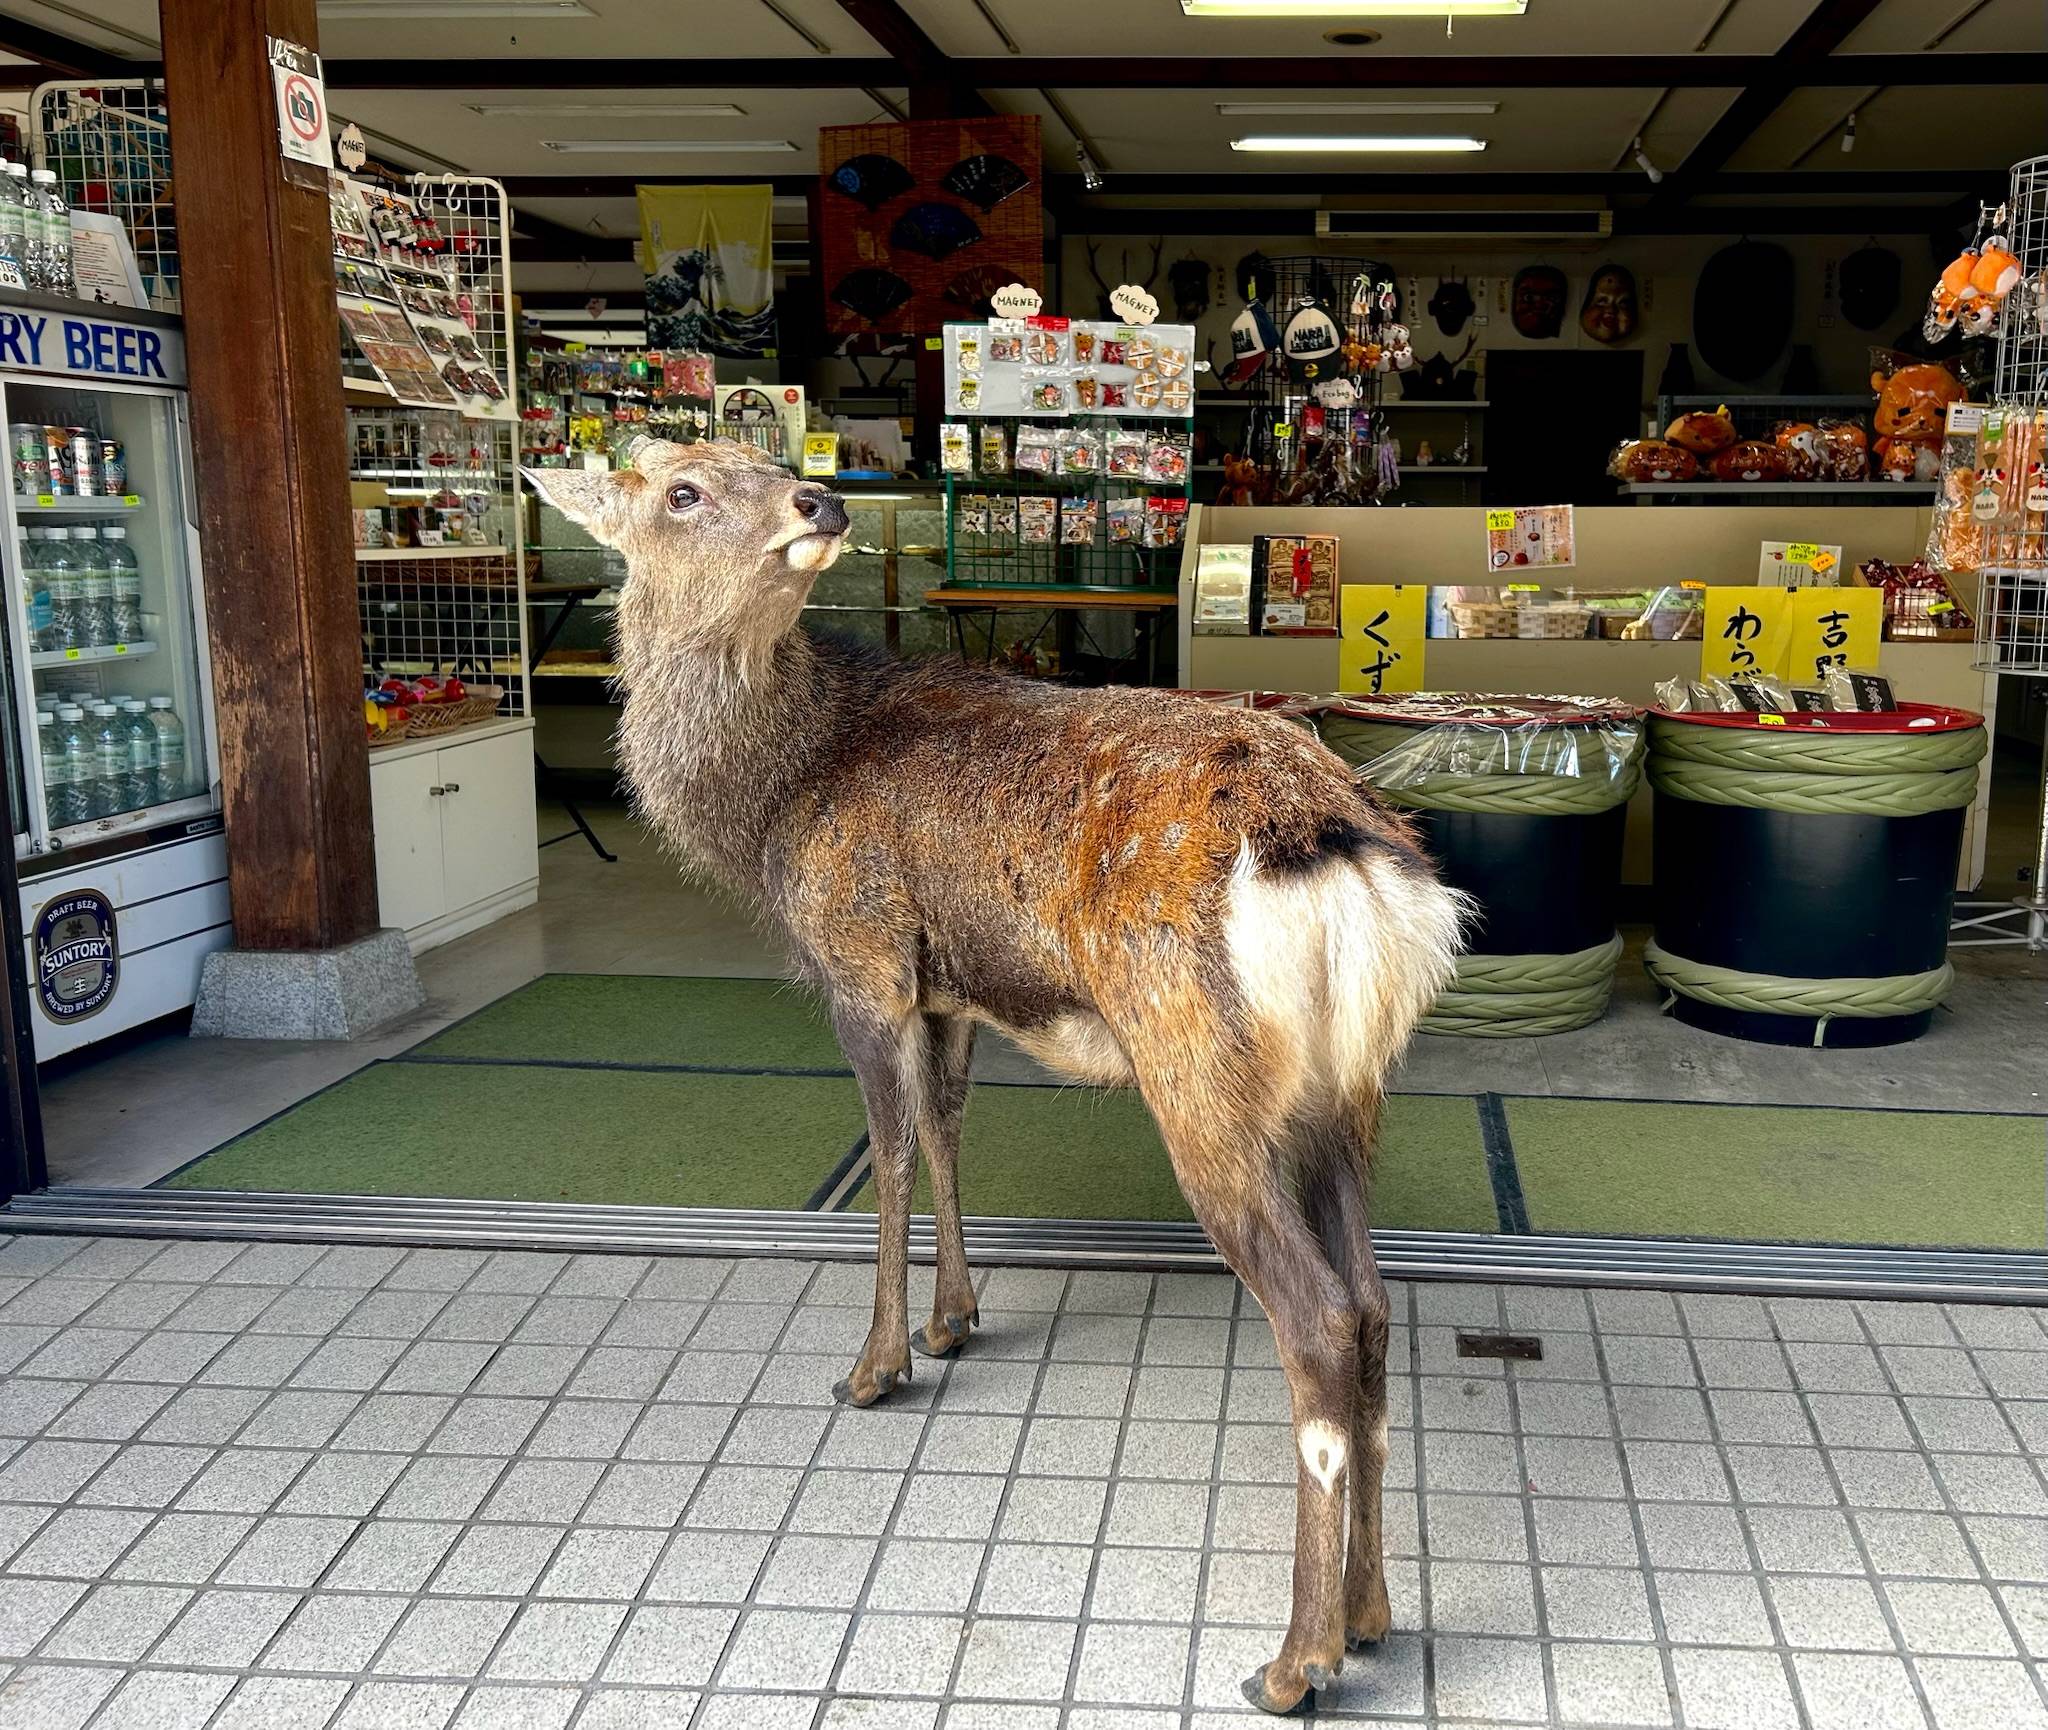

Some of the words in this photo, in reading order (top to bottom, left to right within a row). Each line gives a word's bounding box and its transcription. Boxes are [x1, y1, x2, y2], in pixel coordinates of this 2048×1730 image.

[996, 296, 1040, 309] MAGNET
[1114, 292, 1156, 316] MAGNET
[1293, 327, 1324, 341] NARA
[63, 320, 167, 379] BEER
[1361, 610, 1401, 694] くず
[47, 903, 74, 922] DRAFT
[77, 900, 98, 911] BEER
[45, 942, 107, 973] SUNTORY
[46, 992, 74, 1014] BREWED
[75, 1002, 86, 1011] BY
[86, 973, 113, 1008] SUNTORY
